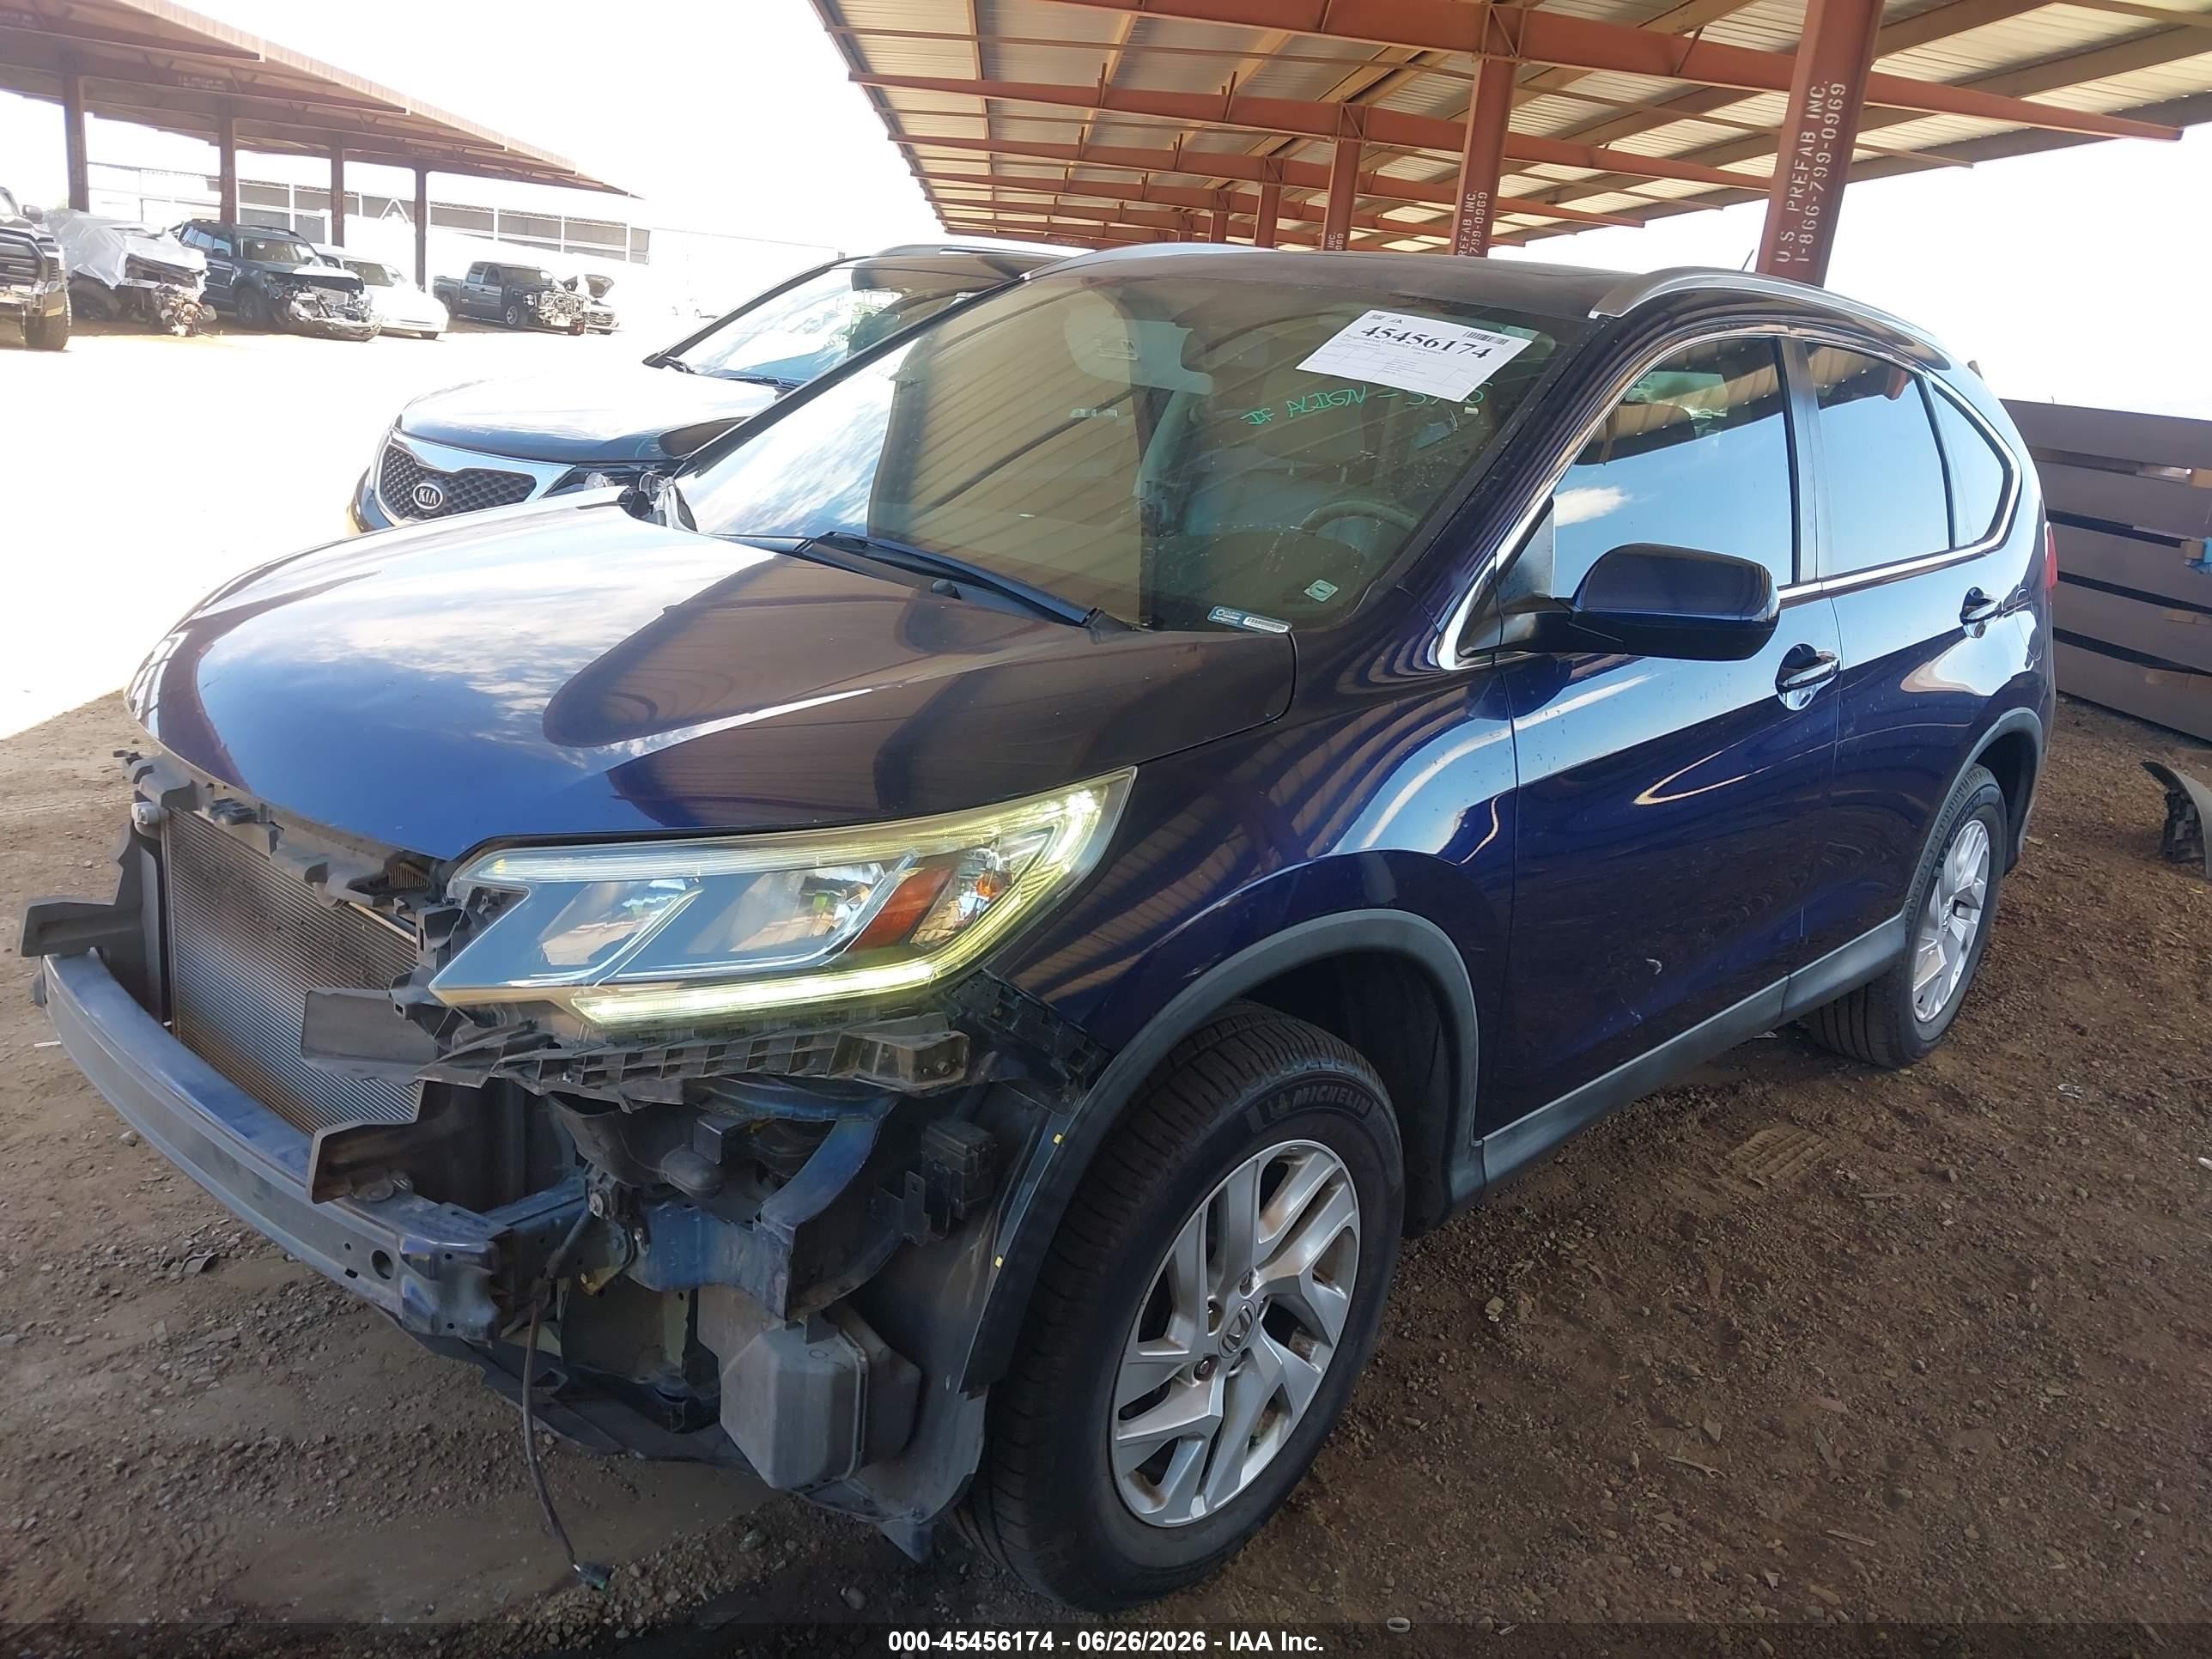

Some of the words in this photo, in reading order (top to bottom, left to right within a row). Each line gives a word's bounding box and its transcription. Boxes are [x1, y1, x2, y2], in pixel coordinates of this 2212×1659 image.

[1786, 131, 1817, 212] PREFAB
[1805, 81, 1829, 119] INC.
[1795, 82, 1847, 262] 1-866-799-0969
[1464, 190, 1477, 212] INC.
[1360, 325, 1493, 359] 45456174
[418, 487, 437, 505] KIA
[1291, 1085, 1375, 1115] MICHELIN
